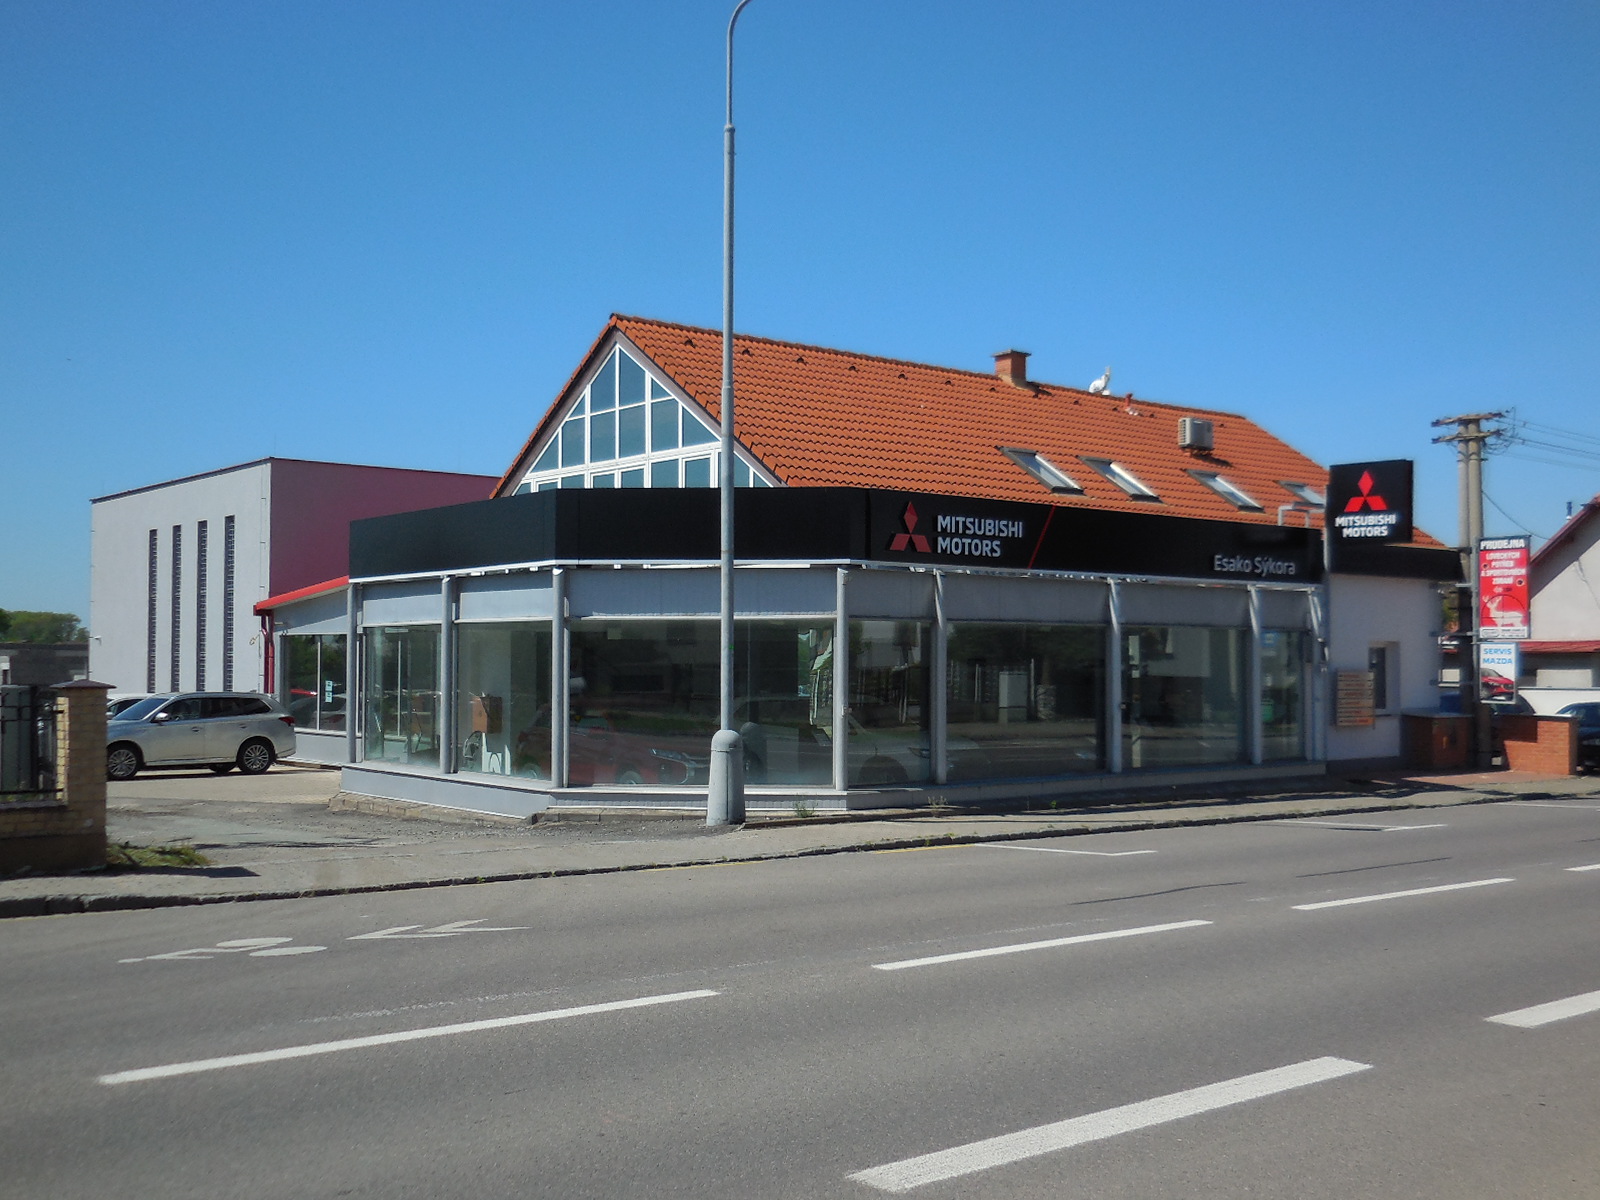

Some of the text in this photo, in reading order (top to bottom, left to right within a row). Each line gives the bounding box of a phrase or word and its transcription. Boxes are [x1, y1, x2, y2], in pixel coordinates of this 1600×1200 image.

[937, 514, 1023, 538] MITSUBISHI
[1334, 513, 1397, 527] MITSUBISHI
[1342, 525, 1389, 538] MOTORS
[937, 536, 1001, 558] MOTORS
[1213, 554, 1296, 577] Esako Sýkora
[1483, 647, 1513, 655] SERVIS
[1482, 657, 1513, 665] MAZDA
